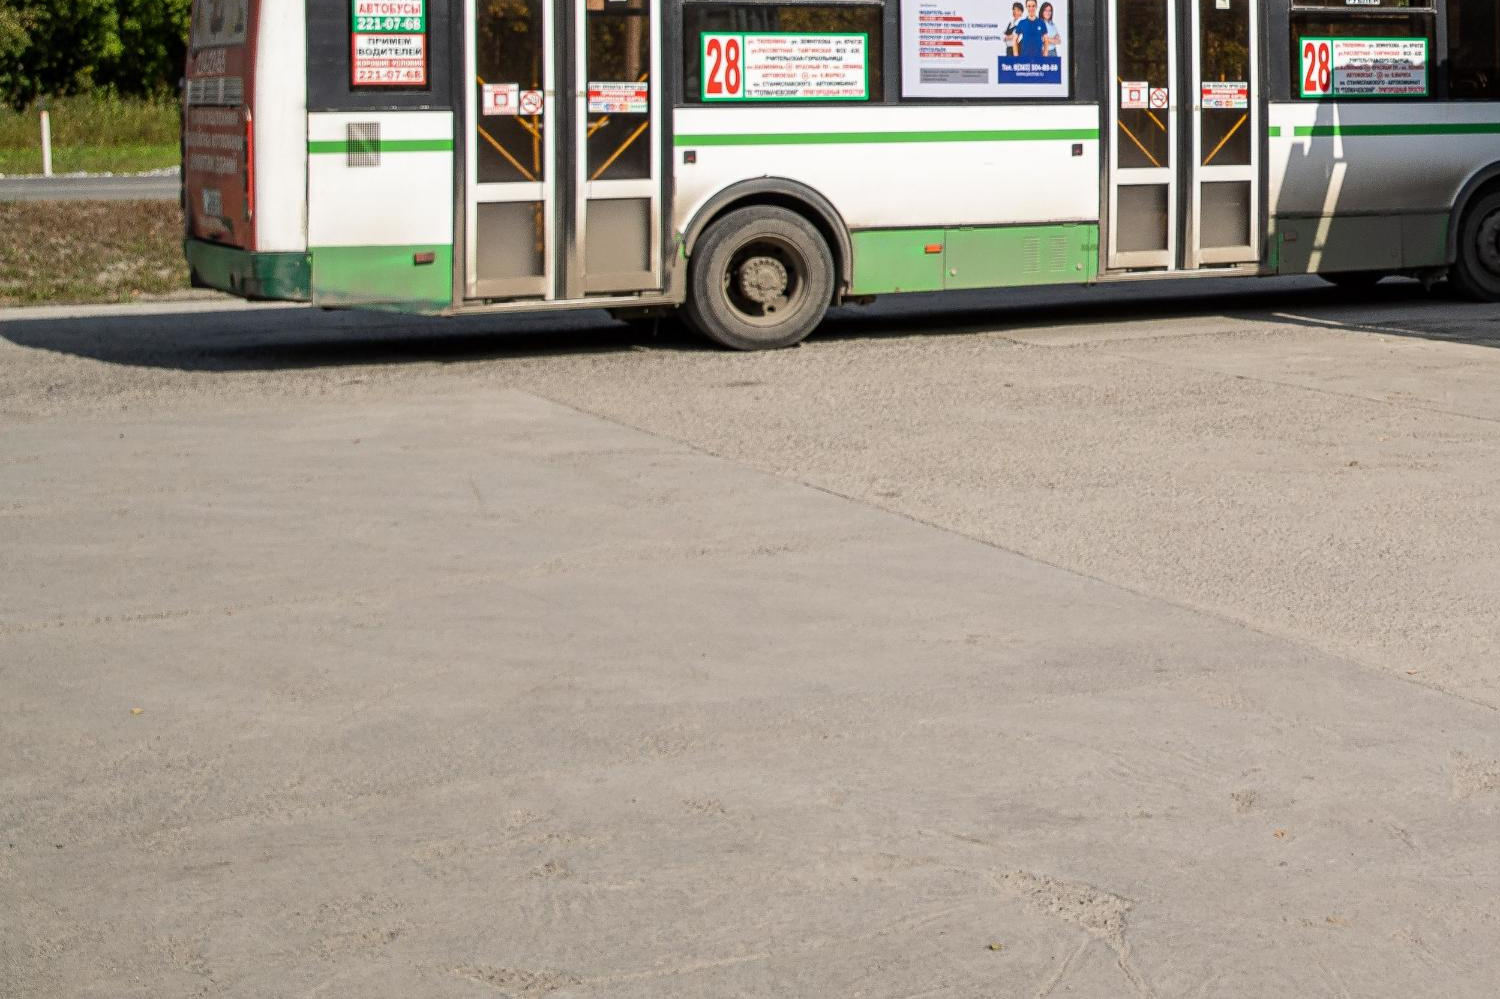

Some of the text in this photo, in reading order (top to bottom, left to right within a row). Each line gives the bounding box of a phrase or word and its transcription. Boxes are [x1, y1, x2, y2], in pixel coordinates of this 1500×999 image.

[359, 3, 421, 14] АВТОБУСЫ
[358, 47, 422, 57] ВОДИТЕЛЕЙ
[706, 38, 741, 95] 28
[1304, 42, 1331, 92] 28
